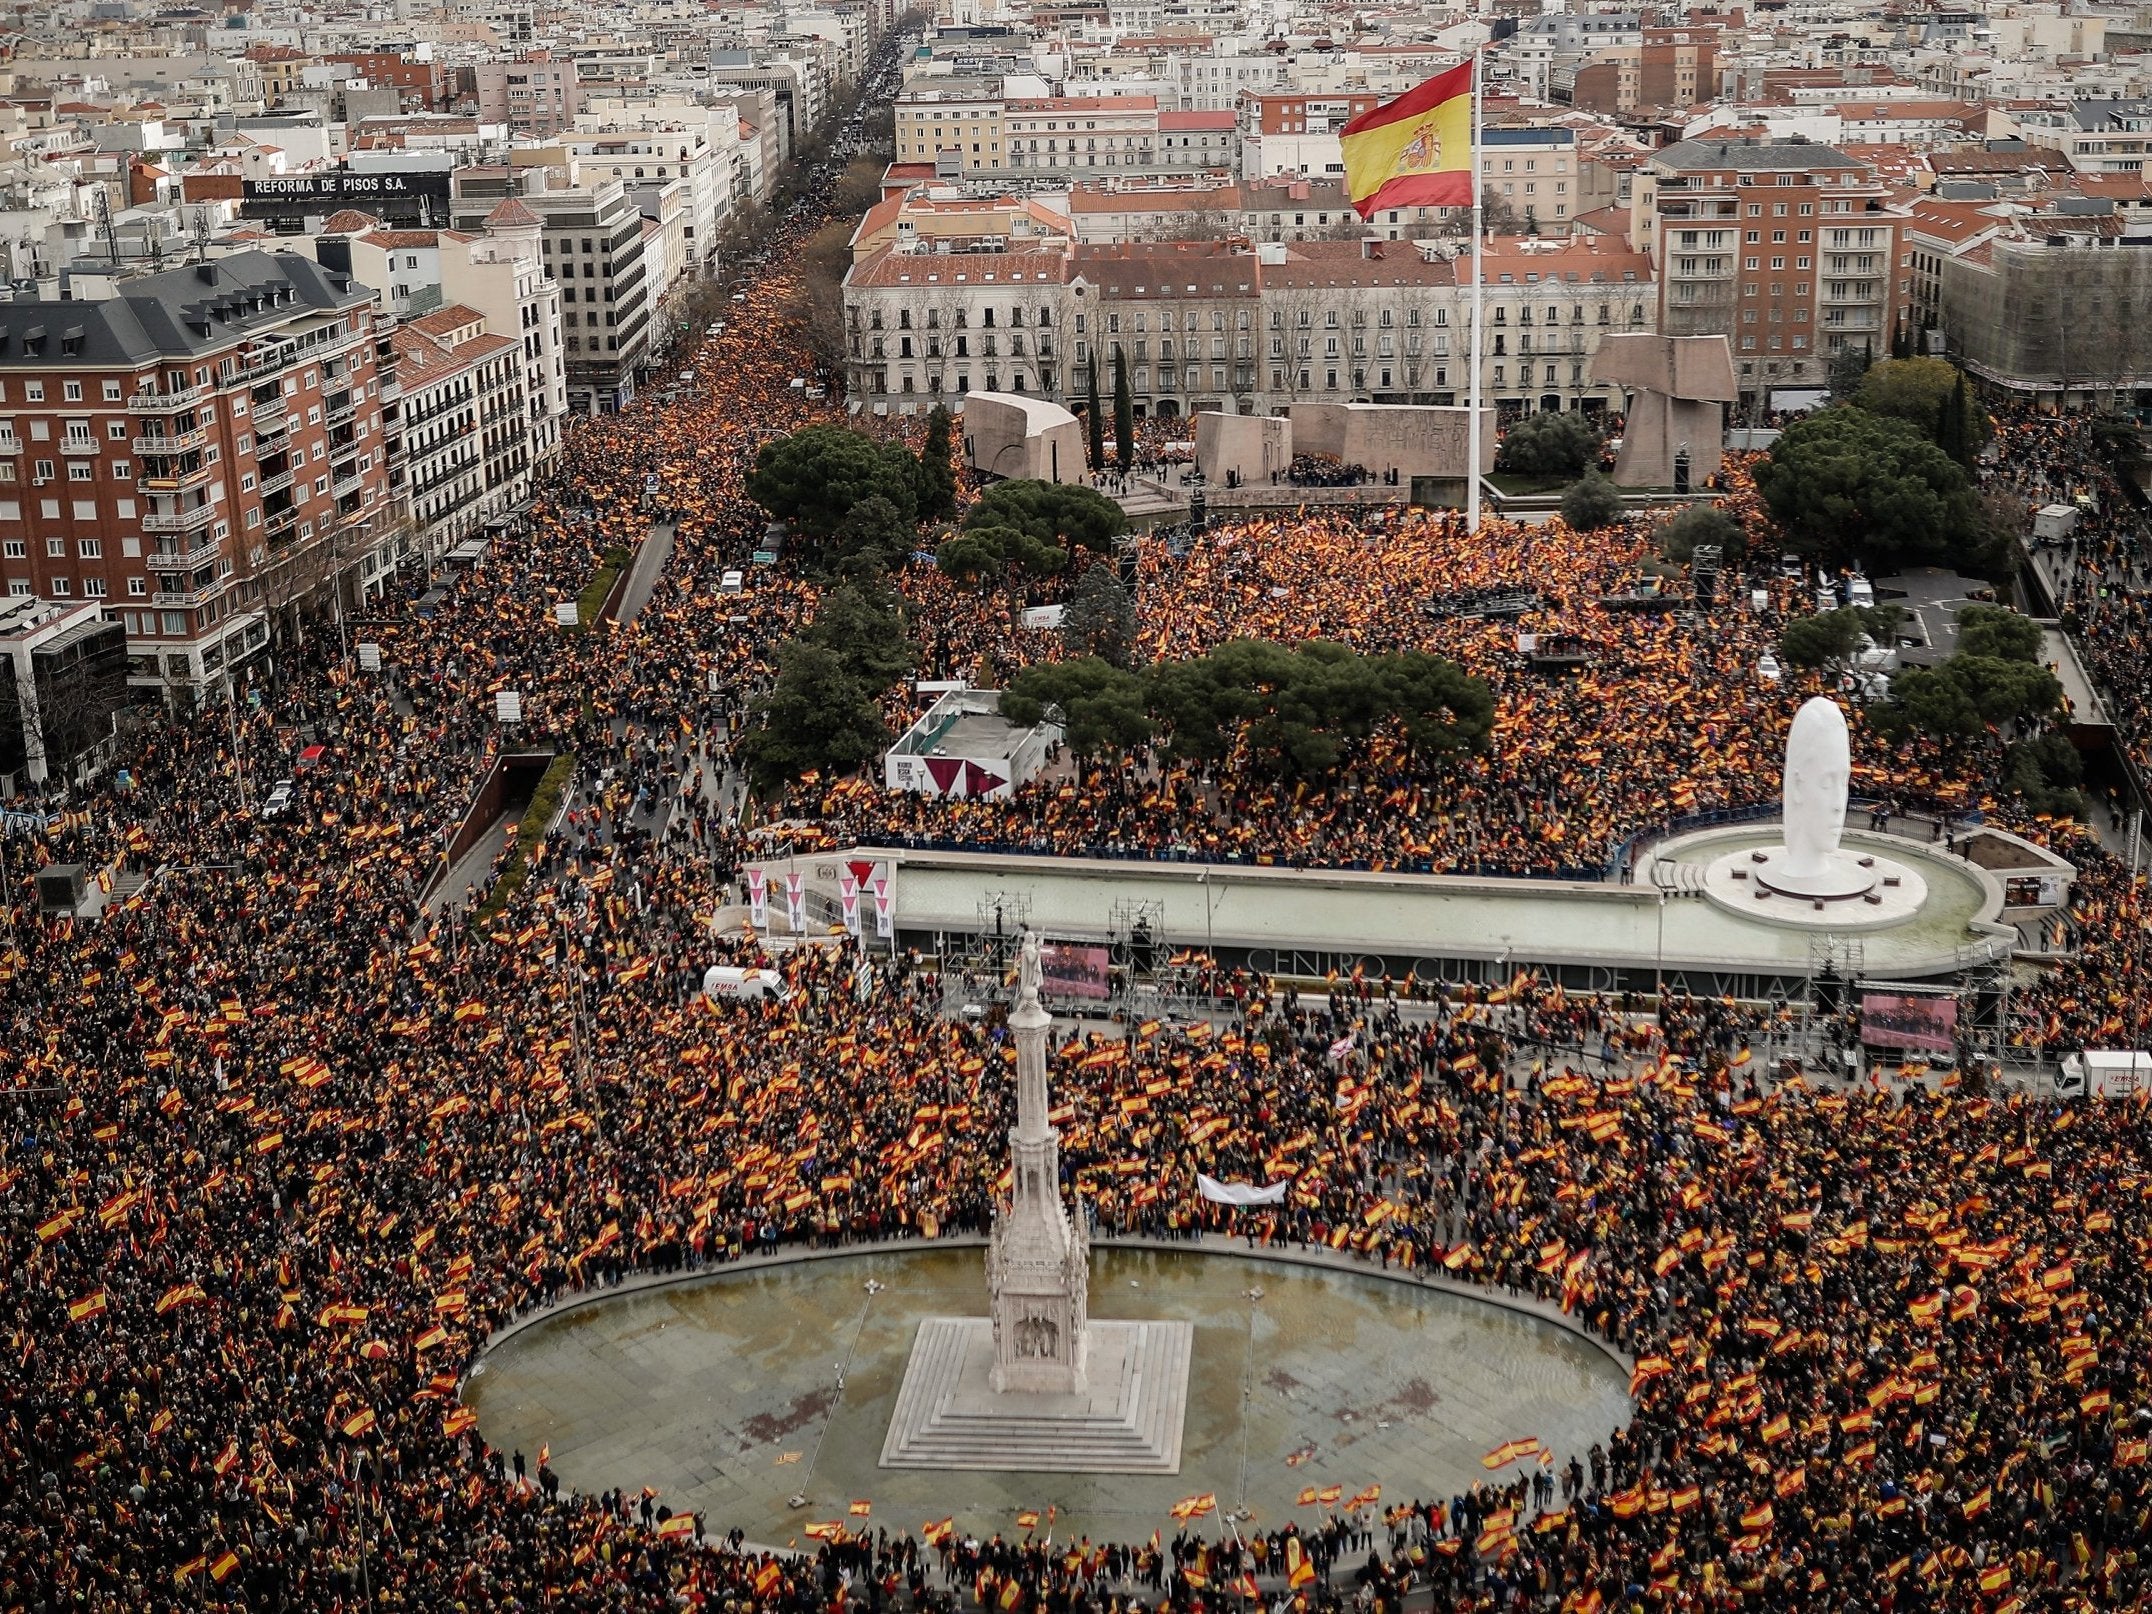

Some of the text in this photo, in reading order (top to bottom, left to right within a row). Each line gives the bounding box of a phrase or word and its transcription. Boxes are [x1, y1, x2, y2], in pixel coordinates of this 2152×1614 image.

[255, 177, 407, 193] REFORMA DE PISOS S.A.
[1248, 949, 1386, 979] CENTRO
[1589, 966, 1630, 993] DE
[1712, 973, 1788, 1001] VILLA
